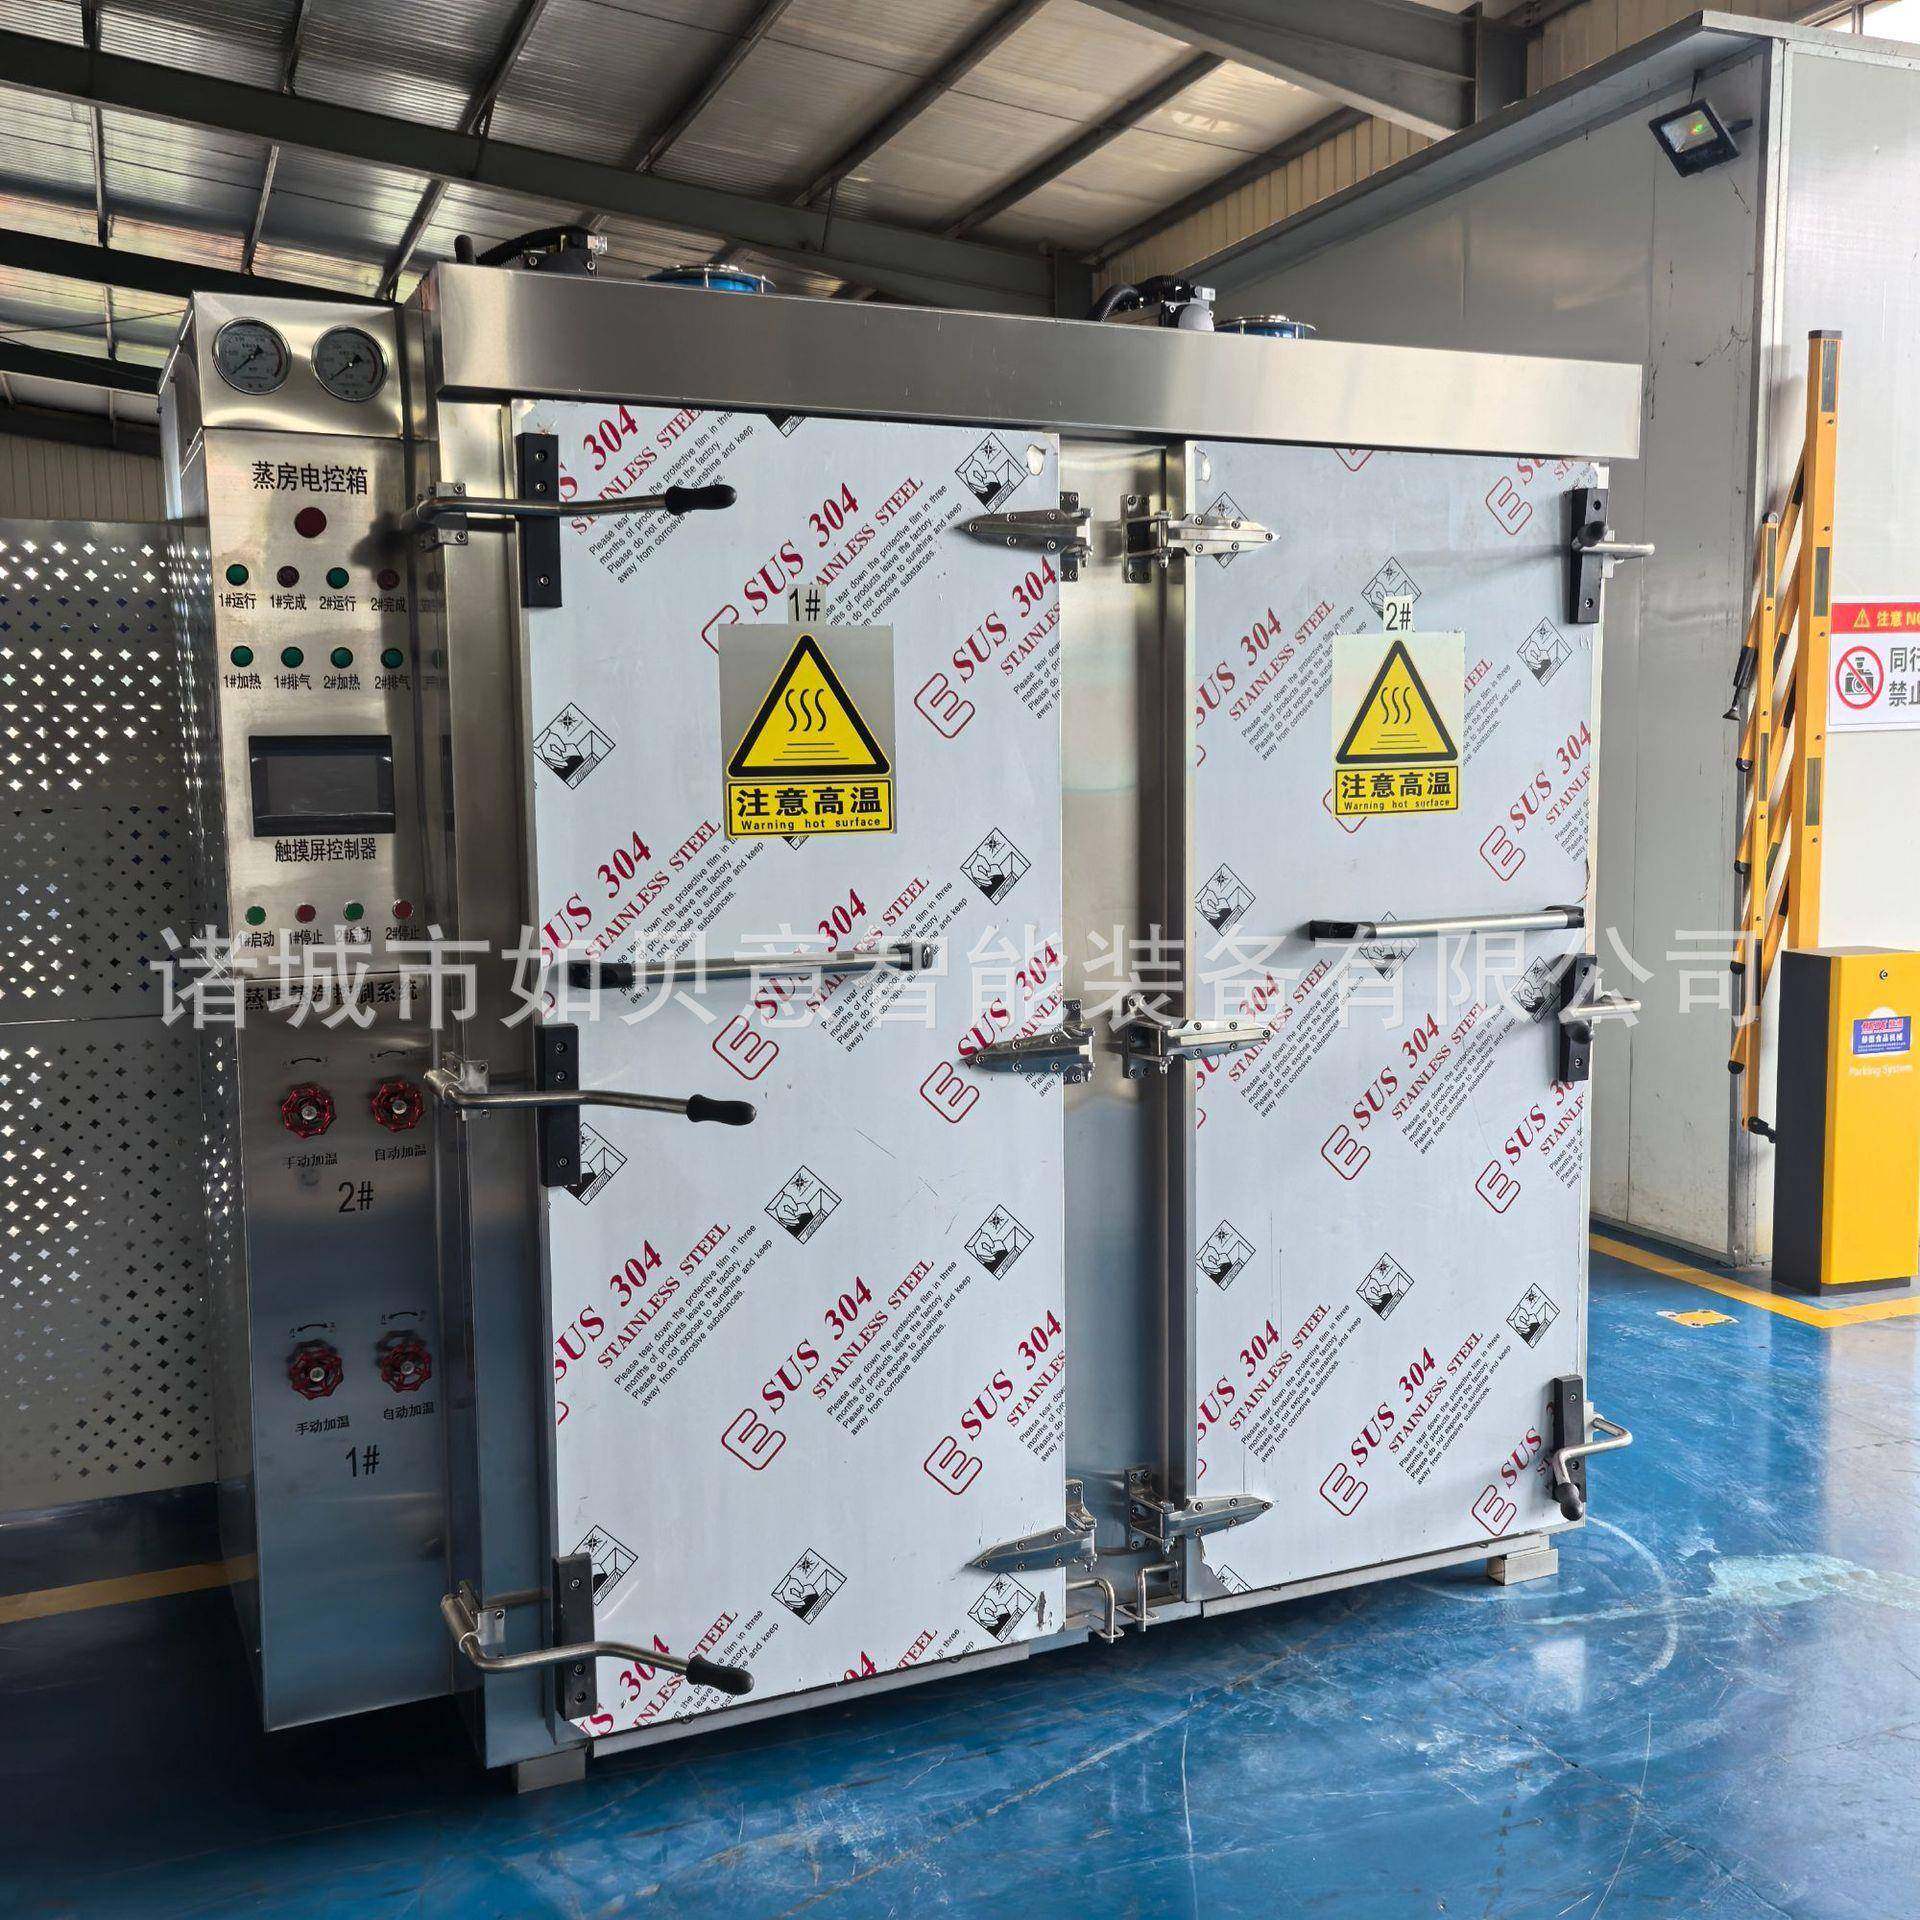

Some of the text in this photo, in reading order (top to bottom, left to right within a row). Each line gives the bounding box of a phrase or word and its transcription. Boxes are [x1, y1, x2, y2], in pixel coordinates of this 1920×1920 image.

[583, 402, 638, 471] 304
[251, 460, 368, 495] 蒸房电控箱
[744, 482, 859, 617] SUS 304
[811, 478, 924, 587] AINLESS STEEL
[835, 588, 849, 604] tear
[850, 570, 868, 589] down
[880, 525, 910, 559] protective
[909, 512, 923, 525] film
[929, 485, 947, 504] three
[874, 573, 897, 598] expose
[905, 534, 933, 564] sunshine
[945, 503, 962, 521] keep
[219, 593, 257, 610] 1#运行
[270, 594, 307, 611] 1#完成
[319, 595, 356, 612] 2#运行
[370, 596, 406, 613] 2#完成
[789, 588, 820, 621] 1#
[853, 573, 881, 604] products
[879, 554, 899, 573] leave
[871, 587, 899, 618] corrosive
[952, 555, 1057, 684] SUS 304
[1240, 607, 1282, 667] 304
[1386, 602, 1411, 631] 2#
[1876, 611, 1902, 627] 注意
[223, 674, 262, 689] 1#加热
[274, 675, 312, 690] 1#排气
[323, 676, 360, 690] 2#加热
[375, 676, 410, 690] 2#排气
[1229, 601, 1335, 722] STAINLESS STEEL
[736, 786, 882, 817] 注意高温
[1341, 772, 1451, 798] 注意高温
[1344, 801, 1385, 811] Warning
[1415, 799, 1450, 807] surface
[1509, 720, 1592, 834] SUS 304
[275, 838, 376, 862] 触摸屏控制器
[741, 817, 881, 830] Warning hot surface
[585, 821, 721, 962] STAINLESS STEEL
[597, 830, 651, 899] 304
[818, 888, 867, 953] 304
[882, 877, 930, 926] STEEL
[1015, 940, 1060, 1002] 304
[1293, 959, 1333, 1004] STEEL
[1353, 1012, 1440, 1132] SUS 304
[1391, 1002, 1488, 1121] STAINLESS STEEL
[282, 1152, 338, 1169] 手动加温
[374, 1144, 427, 1162] 自动加温
[1504, 1103, 1546, 1167] SUS
[338, 1180, 374, 1213] 2#
[597, 1224, 730, 1370] STAINLESS STEEL
[610, 1240, 662, 1307] 304
[614, 1359, 639, 1386] Please
[638, 1341, 653, 1358] tear
[654, 1321, 673, 1341] down
[685, 1270, 717, 1307] protective
[716, 1255, 730, 1269] film
[737, 1225, 756, 1245] three
[631, 1373, 656, 1400] Please
[679, 1319, 703, 1346] expose
[712, 1275, 741, 1308] sunshine
[753, 1240, 771, 1258] keep
[812, 1261, 934, 1400] STAINLESS STEEL
[624, 1365, 649, 1393] months
[658, 1322, 687, 1355] products
[685, 1300, 706, 1321] leave
[641, 1386, 660, 1407] away
[659, 1367, 677, 1385] from
[677, 1332, 706, 1366] corrosive
[762, 1276, 872, 1415] SUS 304
[960, 1309, 1062, 1442] SUS 304
[1229, 1304, 1331, 1431] STAINLESS STEEL
[1240, 1319, 1279, 1377] 304
[383, 1402, 435, 1420] 自动加温
[1350, 1347, 1435, 1468] SUS 304
[1388, 1332, 1484, 1454] STAINLESS STEEL
[295, 1415, 350, 1435] 手动加温
[346, 1444, 380, 1477] 1#
[1501, 1426, 1542, 1490] SUS
